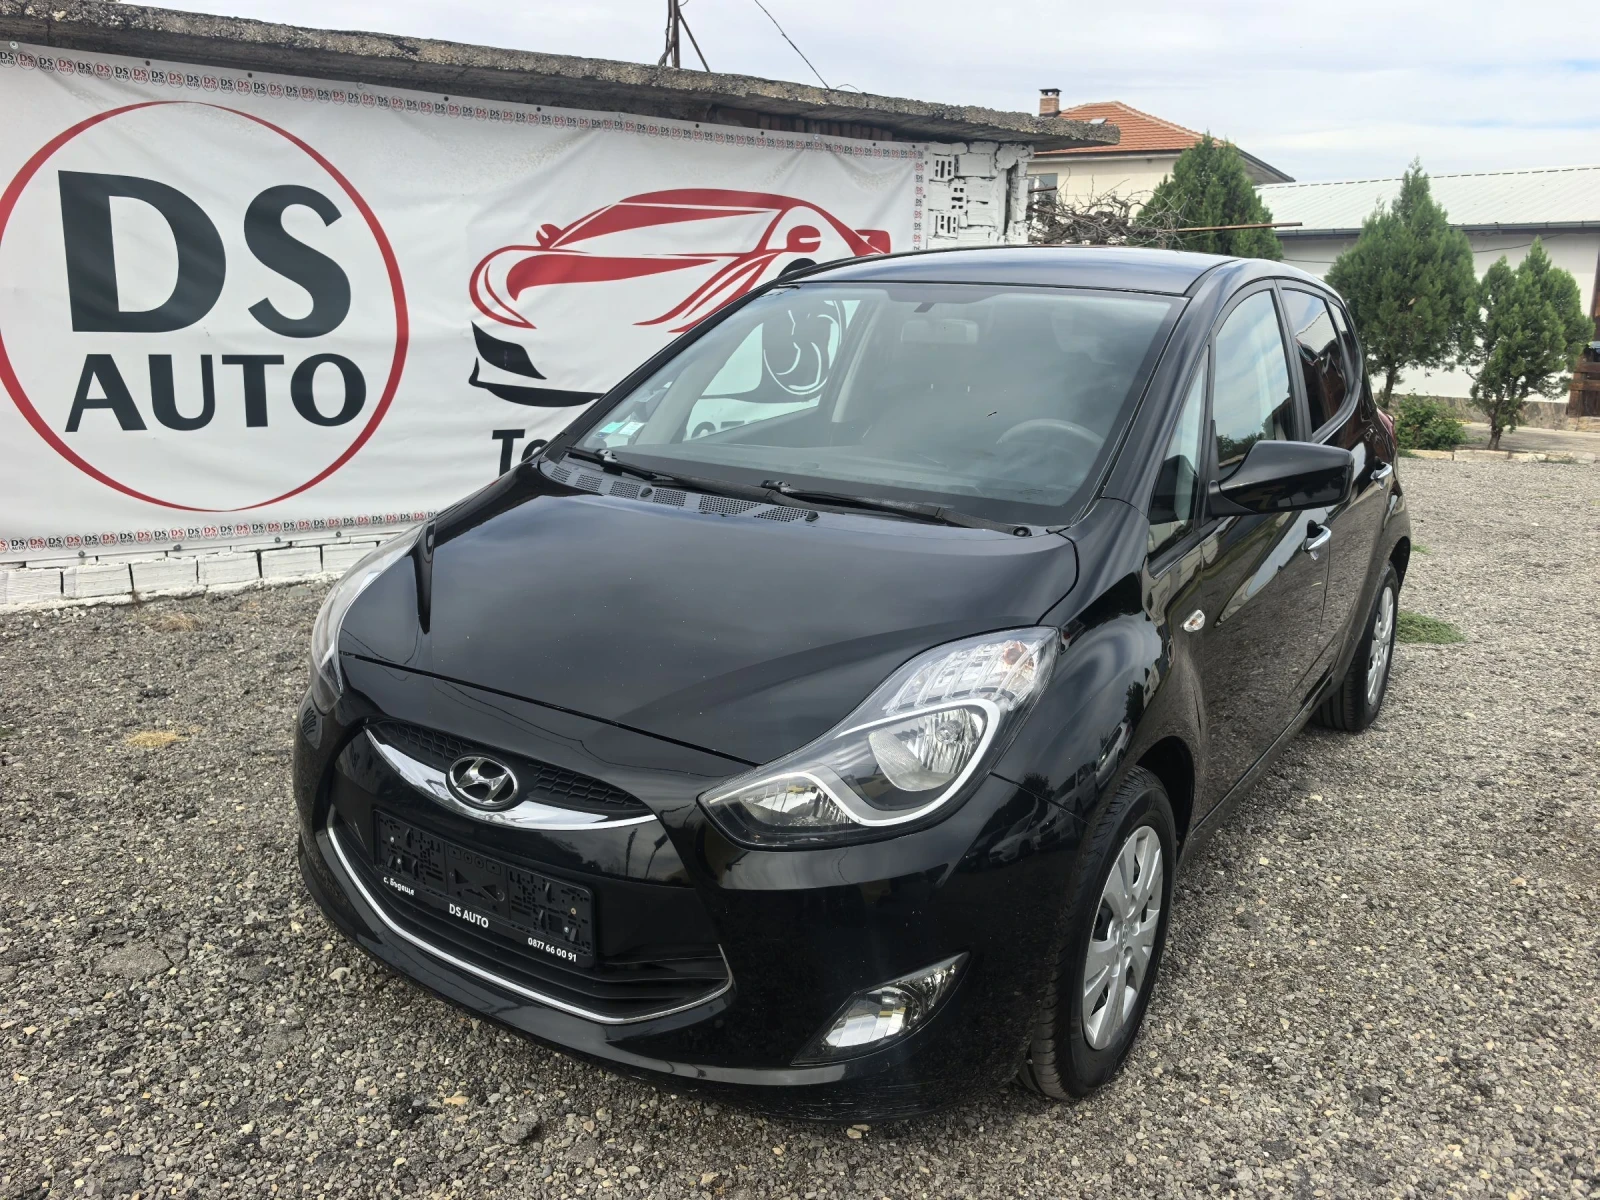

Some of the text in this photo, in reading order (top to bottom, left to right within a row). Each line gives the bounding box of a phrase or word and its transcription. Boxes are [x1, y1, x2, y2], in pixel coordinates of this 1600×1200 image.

[0, 52, 14, 60] DS
[20, 54, 34, 62] DS
[40, 58, 52, 66] DS
[59, 60, 72, 68] DS
[78, 62, 91, 70] DS
[97, 64, 110, 73] DS
[134, 69, 146, 77] DS
[58, 170, 352, 338] DS
[65, 353, 367, 432] AUTO
[449, 903, 489, 928] DS AUTO
[528, 937, 576, 962] 0877 66 00 91
